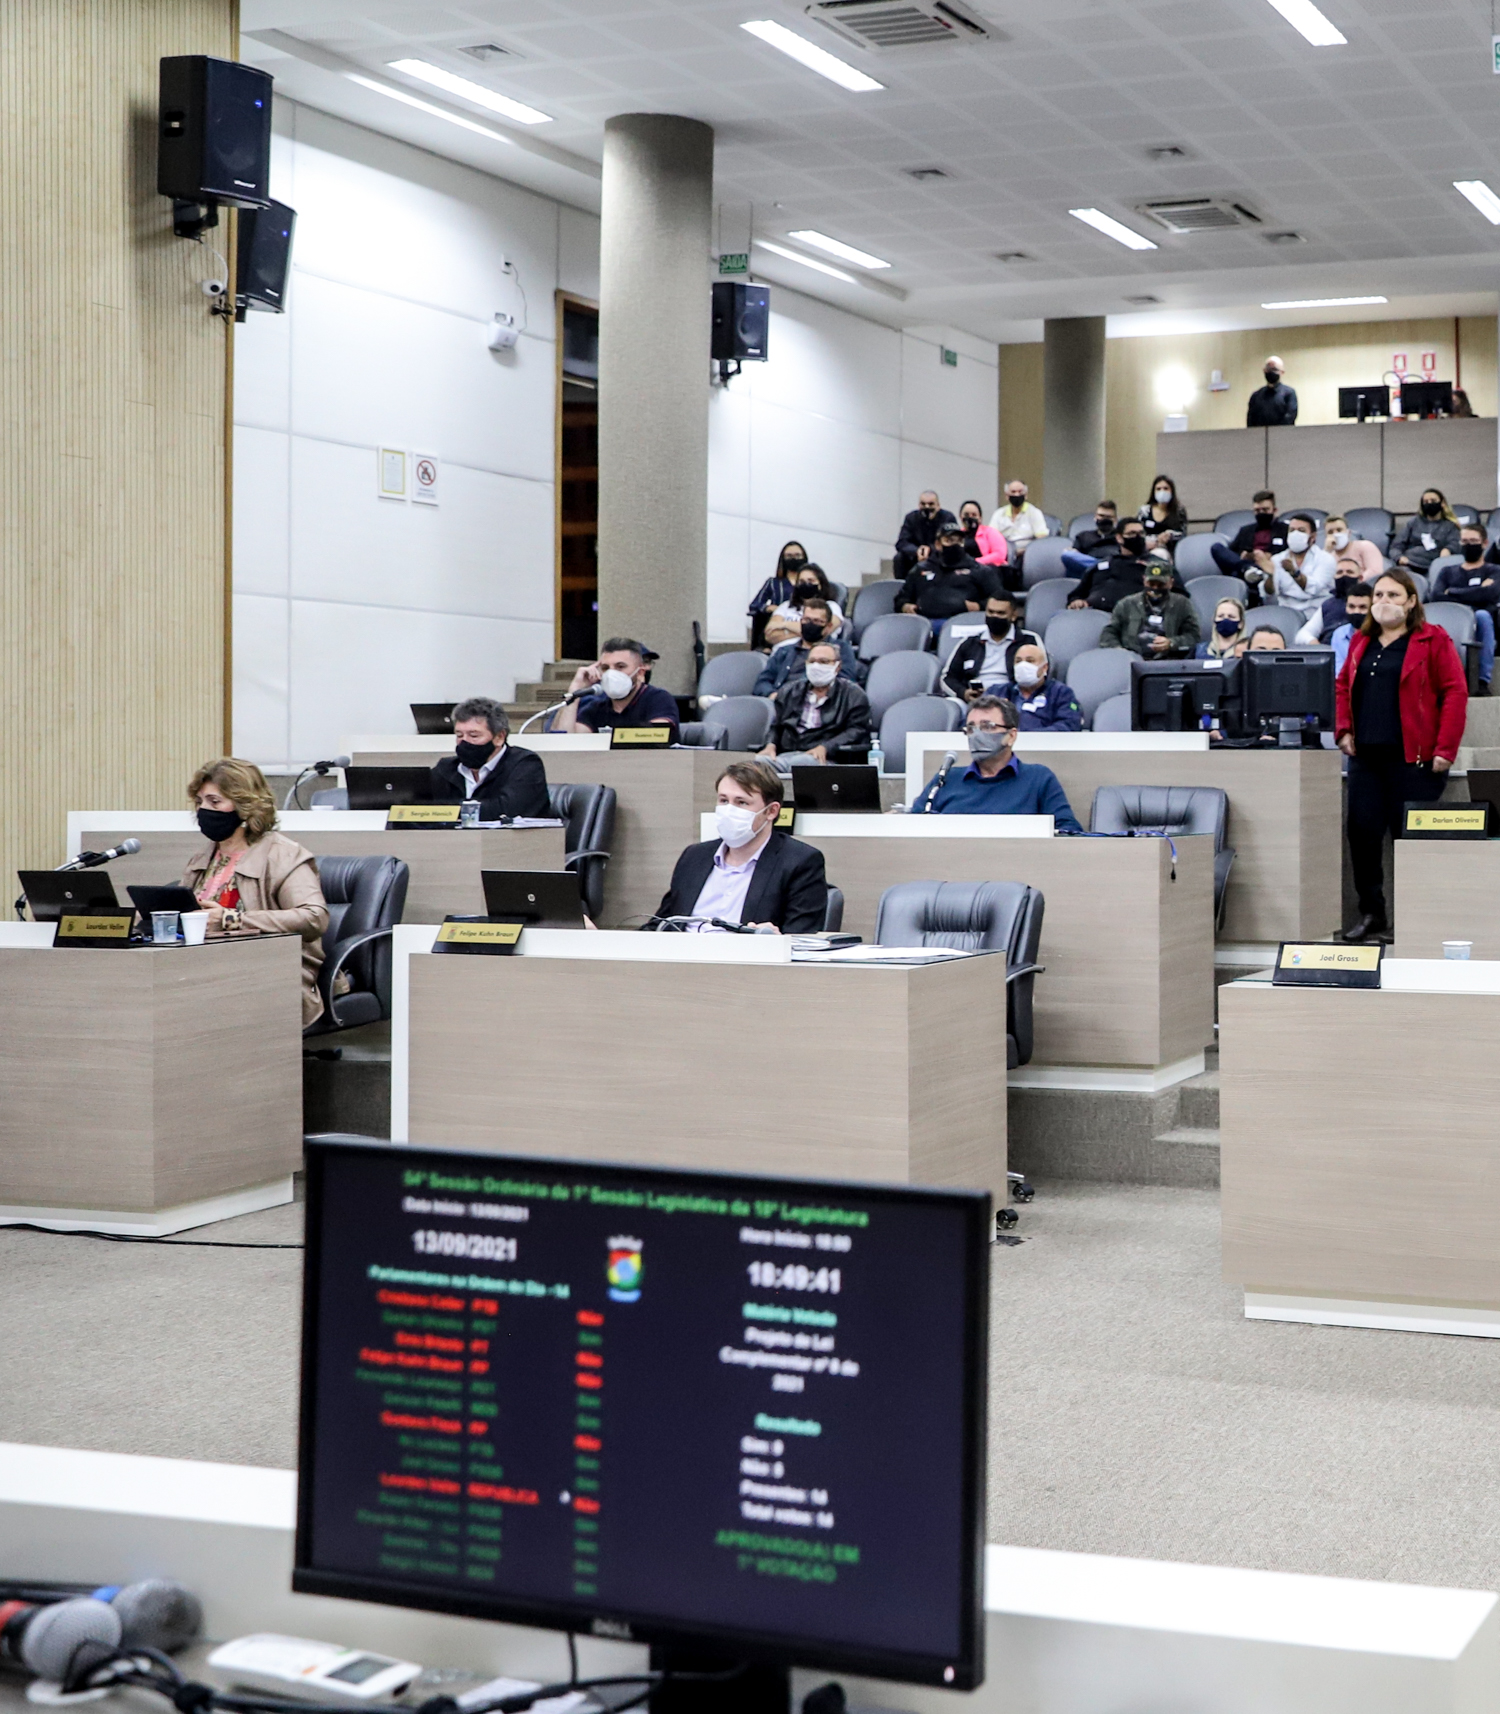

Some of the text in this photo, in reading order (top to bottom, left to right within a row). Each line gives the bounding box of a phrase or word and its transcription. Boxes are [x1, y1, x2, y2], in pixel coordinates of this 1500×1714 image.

[459, 930, 478, 938] Felipe
[1319, 954, 1359, 962] Joel Gross
[428, 1172, 480, 1192] Sessão
[589, 1185, 644, 1207] Sessão
[646, 1191, 729, 1214] Legislativa
[780, 1202, 869, 1227] Legislatura
[412, 1229, 517, 1262] 13/09/2021
[748, 1260, 841, 1294] 18:49:41
[754, 1412, 822, 1437] Resultado
